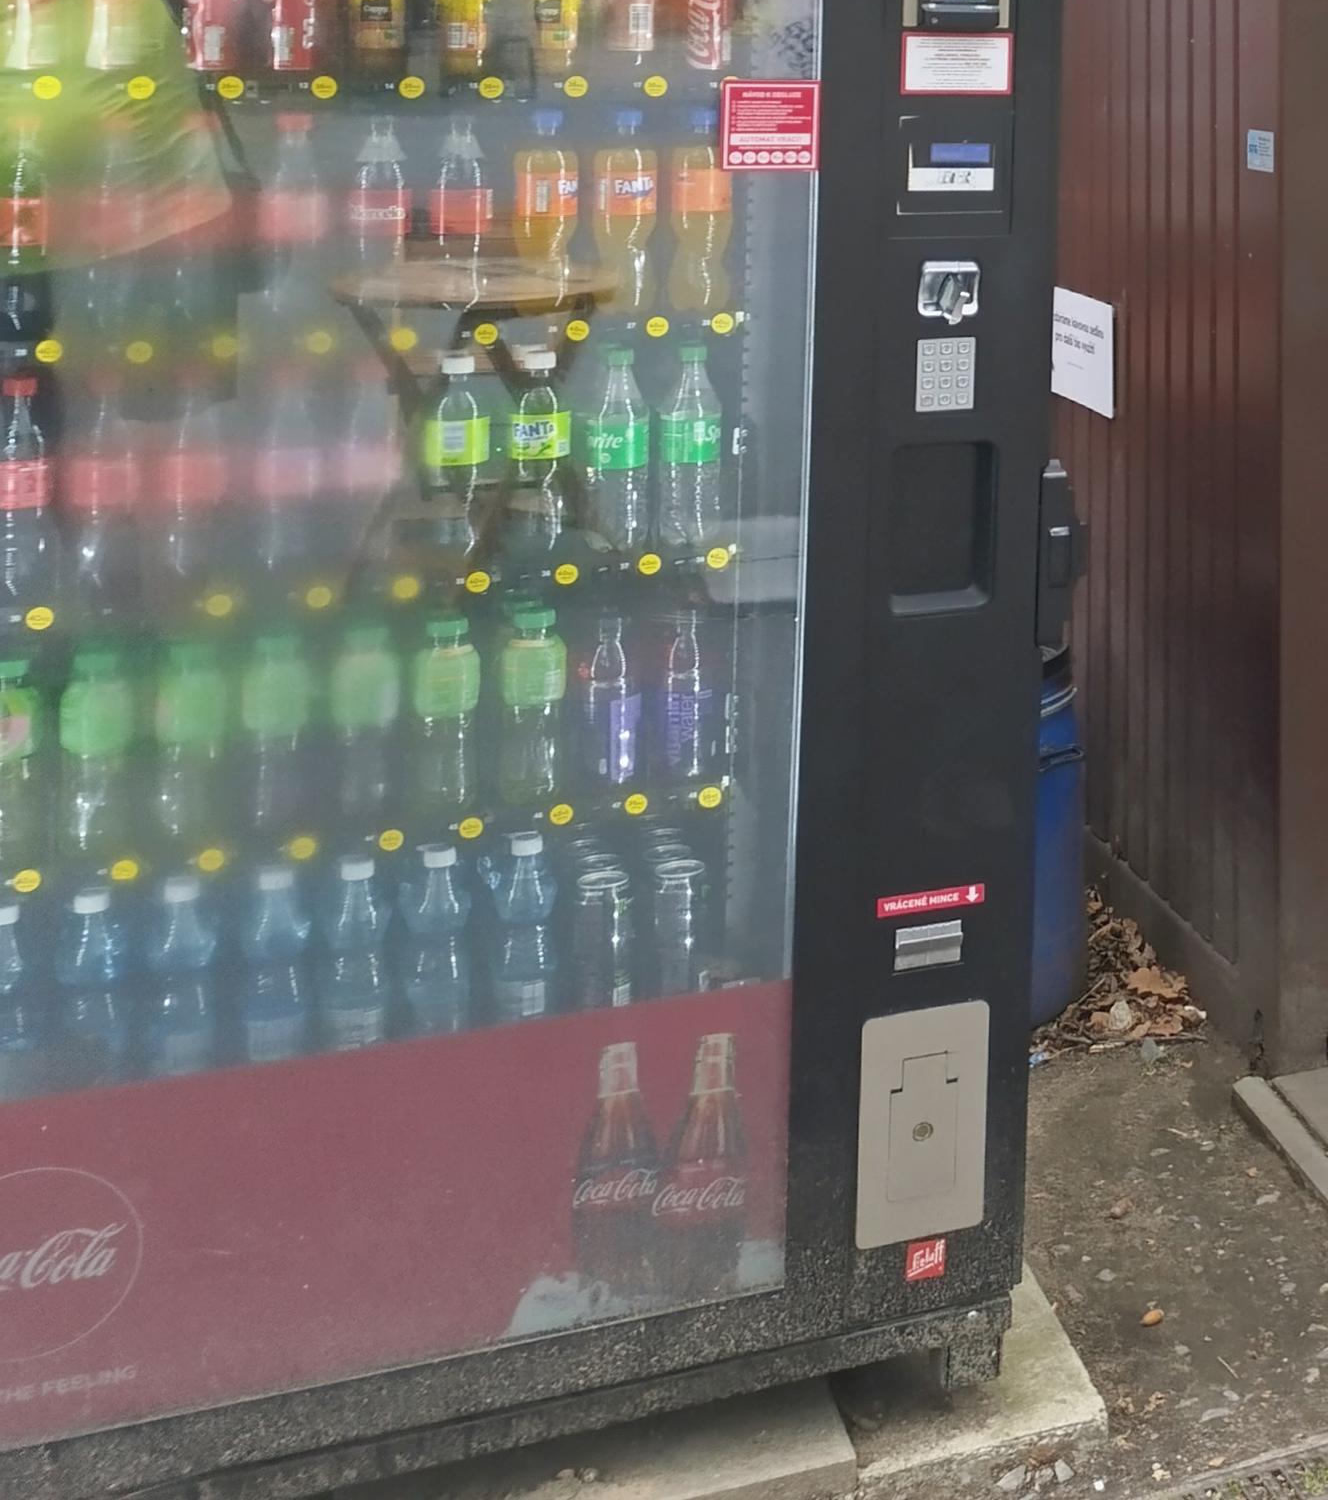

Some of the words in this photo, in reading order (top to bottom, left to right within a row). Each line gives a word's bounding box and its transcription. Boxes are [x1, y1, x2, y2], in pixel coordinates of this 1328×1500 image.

[883, 895, 929, 913] VRÁCENÉ
[929, 892, 961, 906] MINCE
[41, 1364, 138, 1398] FEELING
